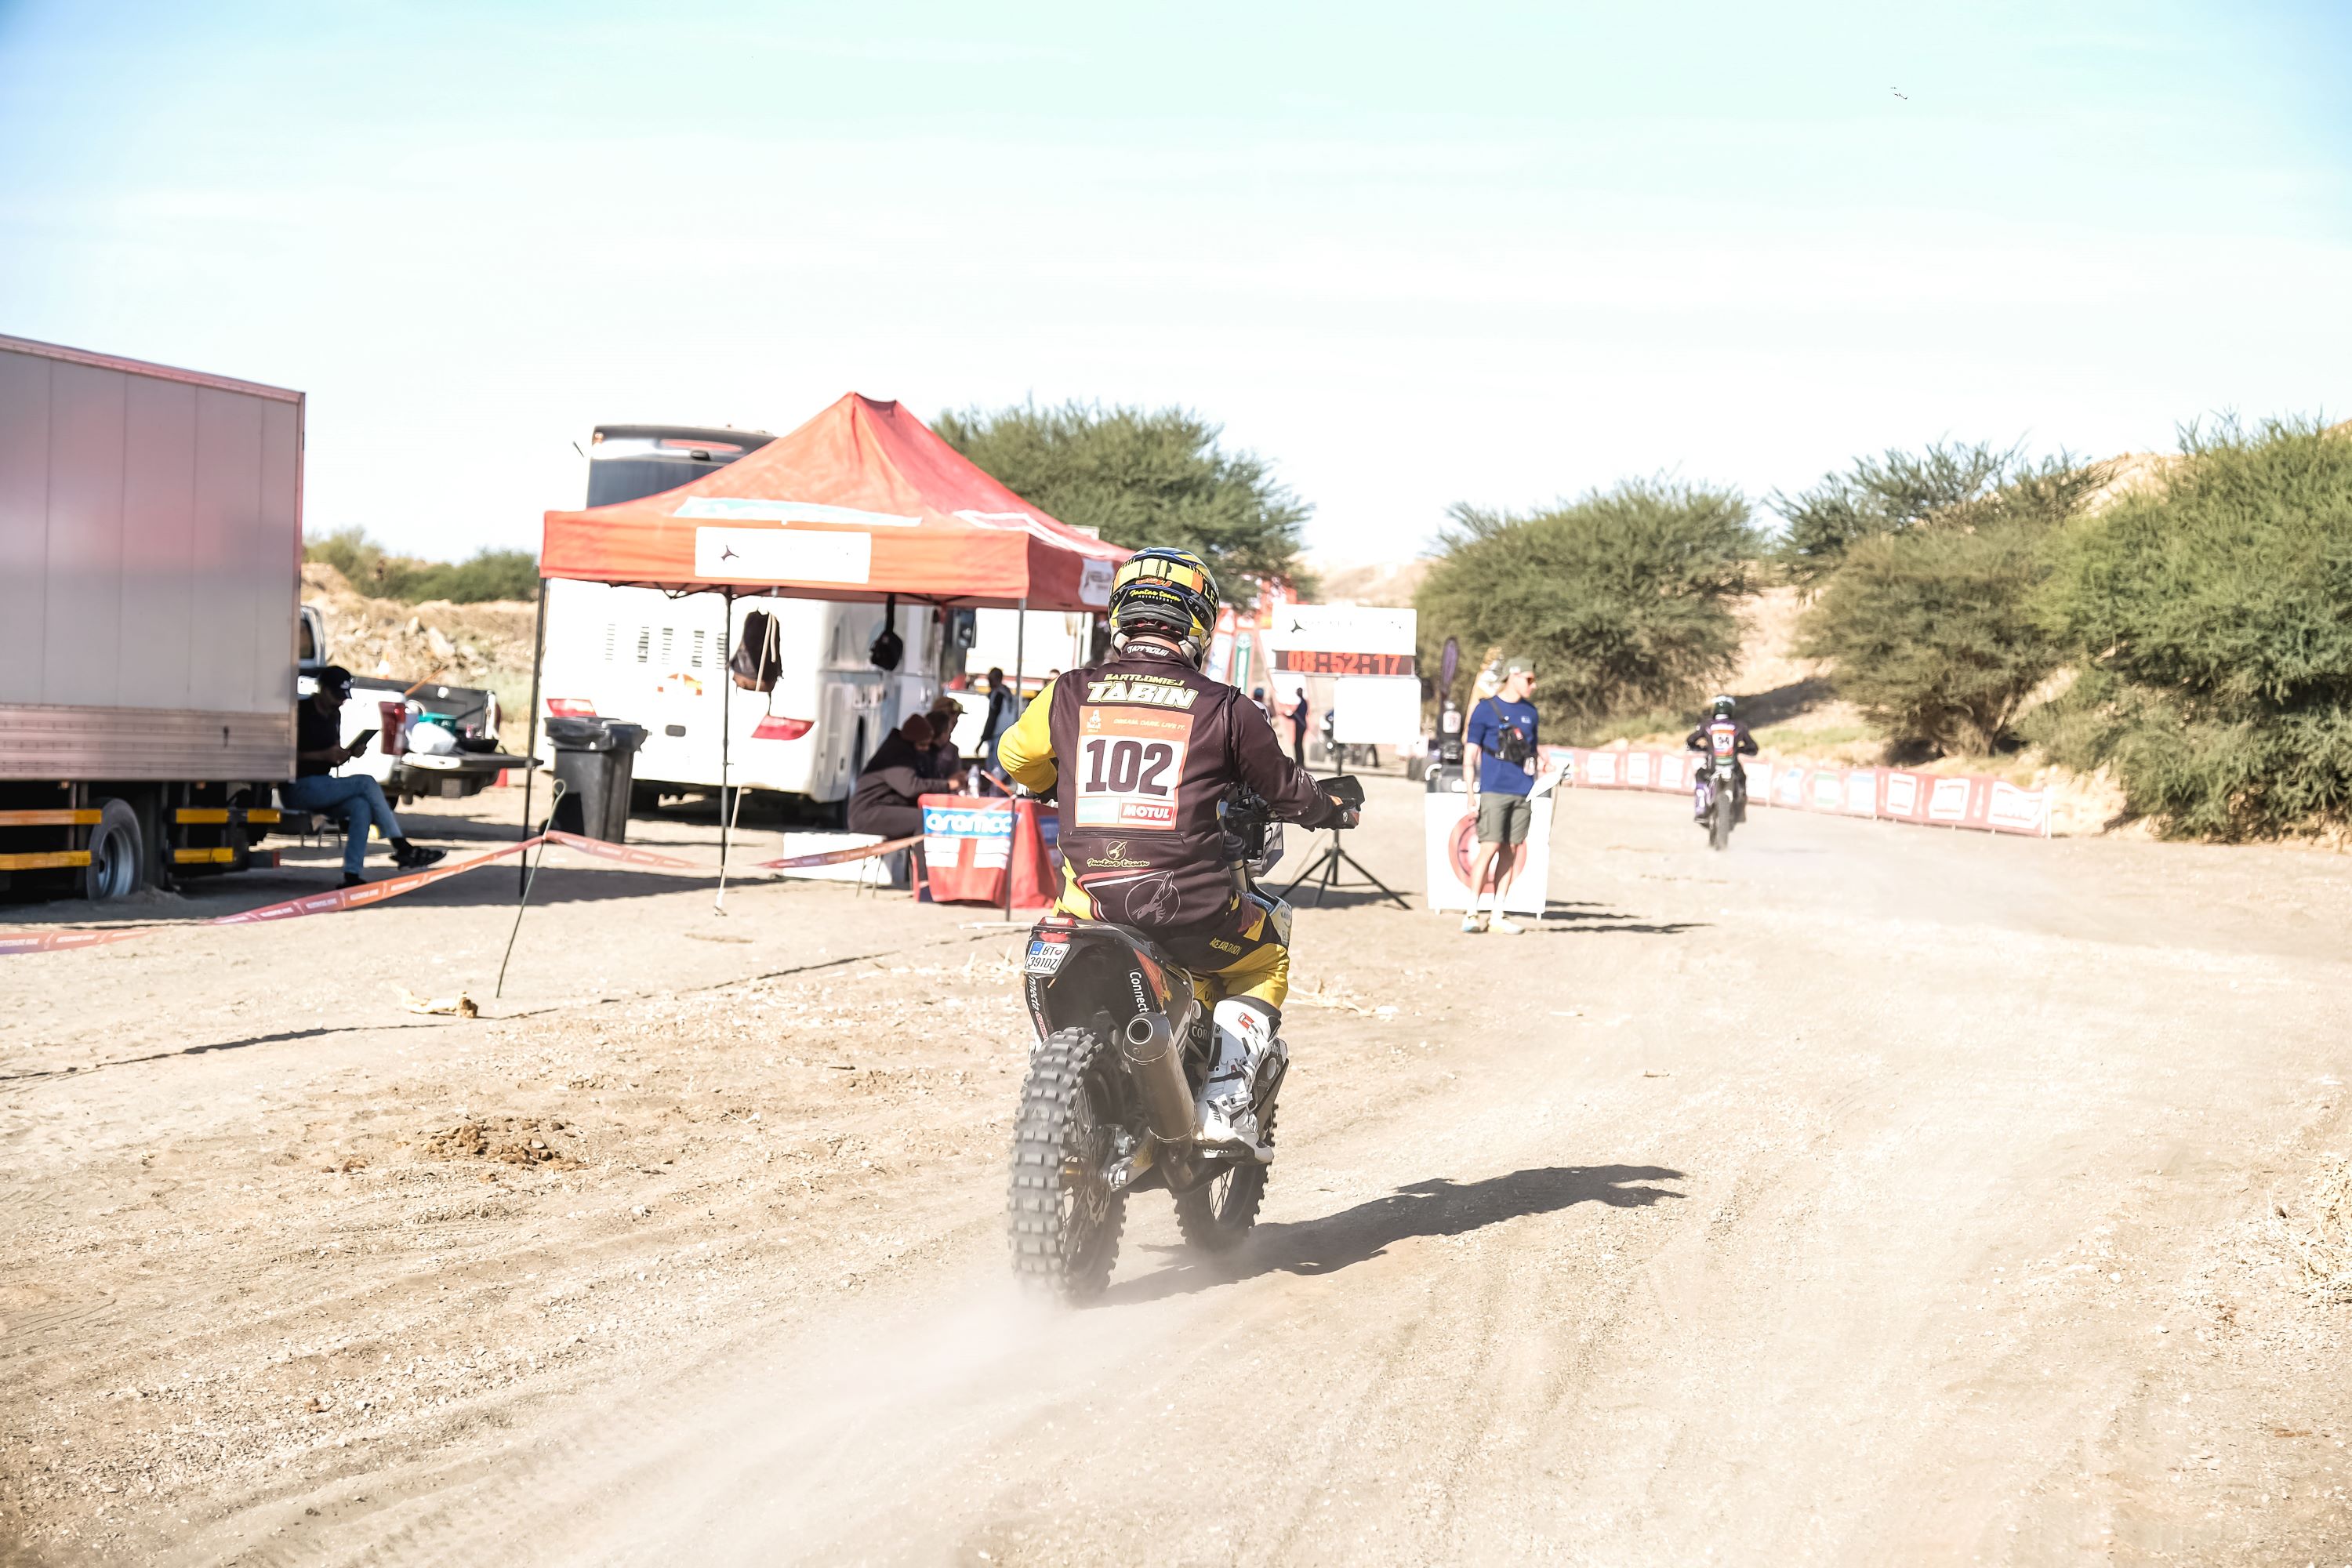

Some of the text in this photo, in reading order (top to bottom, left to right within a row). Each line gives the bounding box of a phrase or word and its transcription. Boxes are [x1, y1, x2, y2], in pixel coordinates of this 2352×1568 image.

[1287, 651, 1401, 675] 08:52:17
[1087, 681, 1199, 710] TABIN
[1085, 739, 1174, 797] 102
[1123, 804, 1171, 818] MOTUL
[1042, 946, 1057, 956] BT
